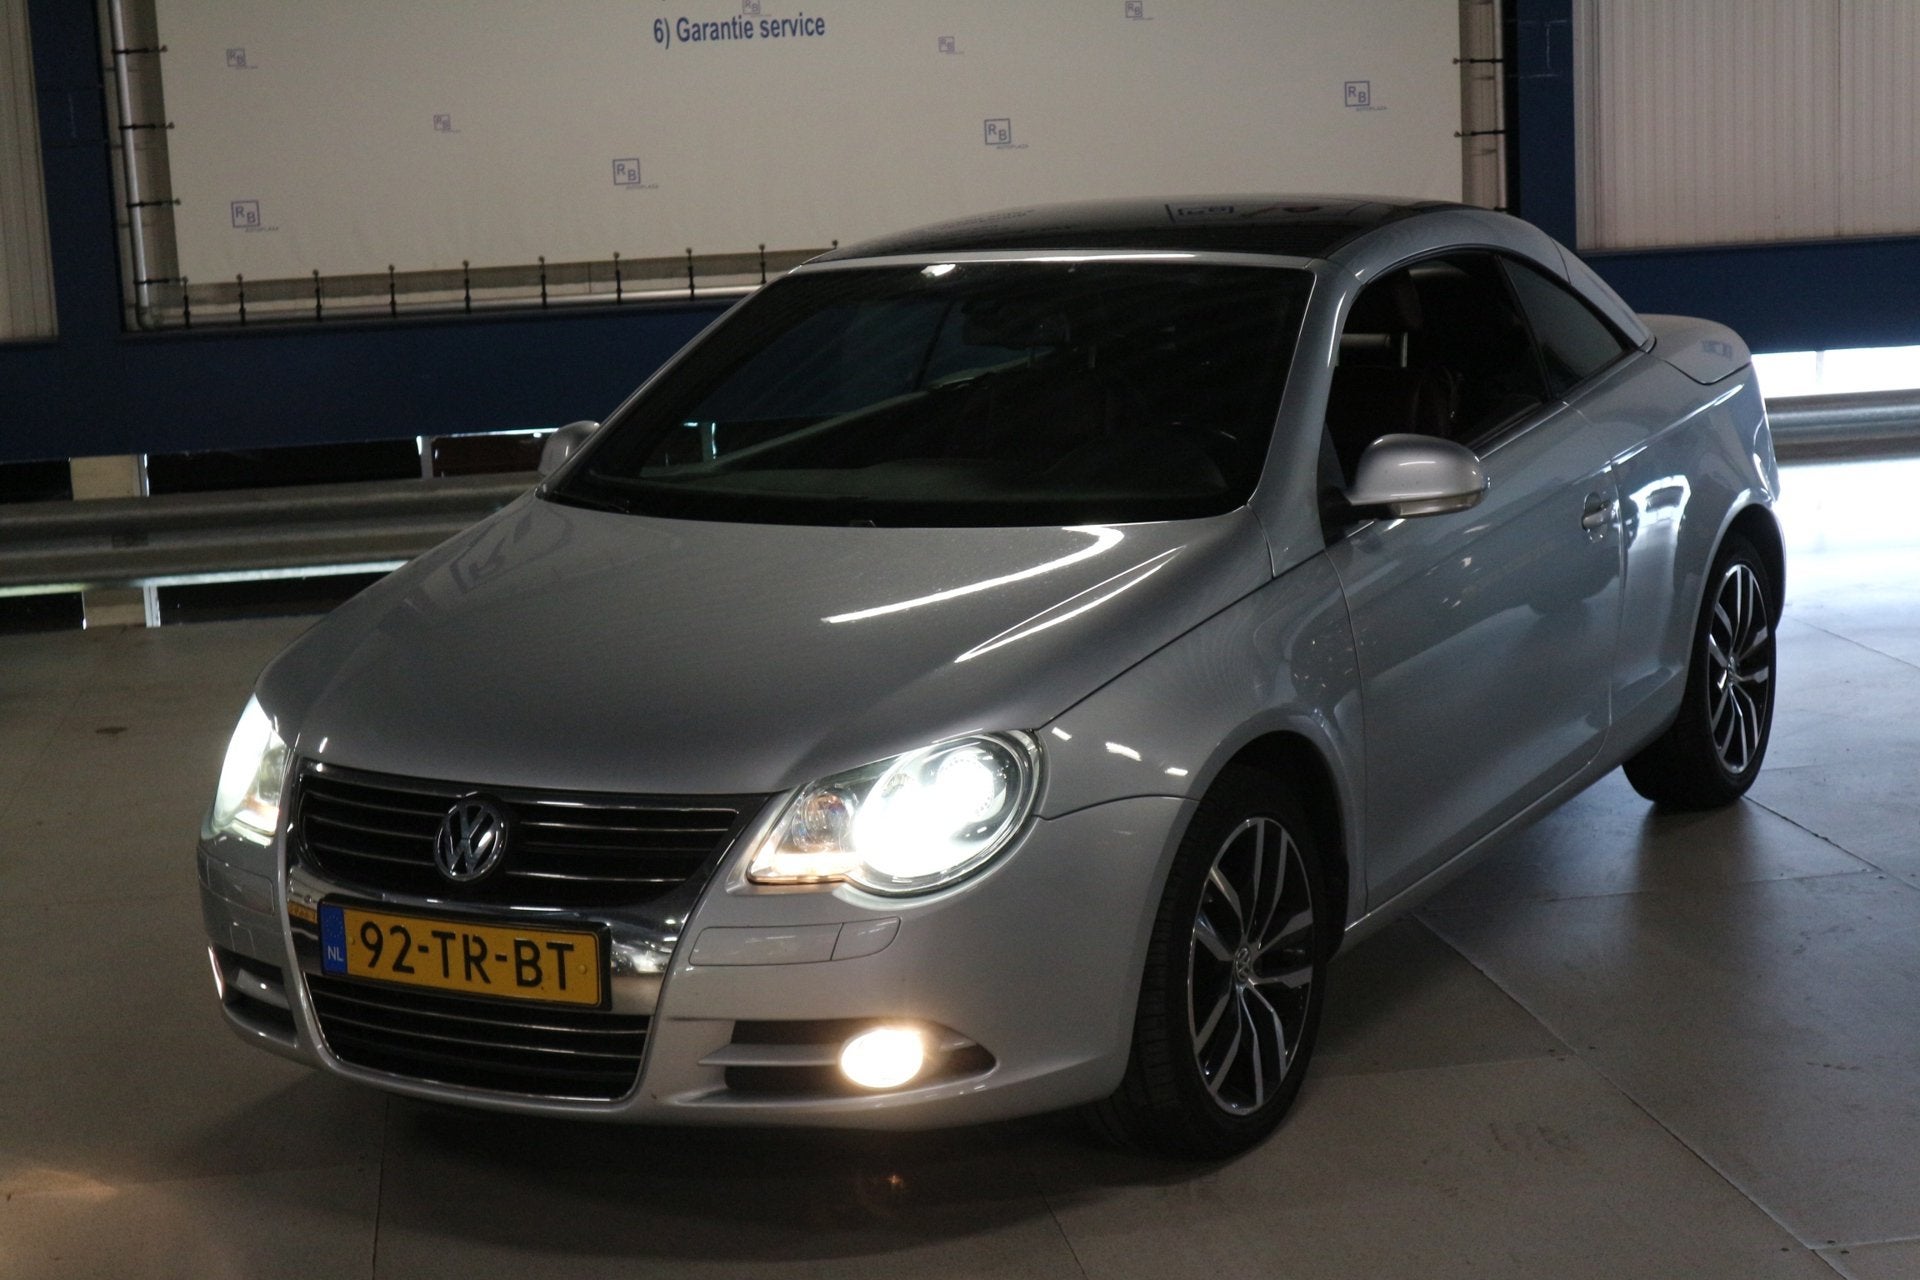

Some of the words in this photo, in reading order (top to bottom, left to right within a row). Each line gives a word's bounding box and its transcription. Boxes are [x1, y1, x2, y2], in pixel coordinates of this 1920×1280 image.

[653, 18, 670, 50] 6)
[676, 15, 754, 42] Garantie
[759, 12, 826, 38] service
[1347, 85, 1367, 104] RB
[987, 123, 1008, 141] RB
[616, 162, 638, 181] RB
[234, 205, 257, 224] RB
[327, 945, 344, 963] NL
[359, 920, 575, 991] 92-TR-BT
